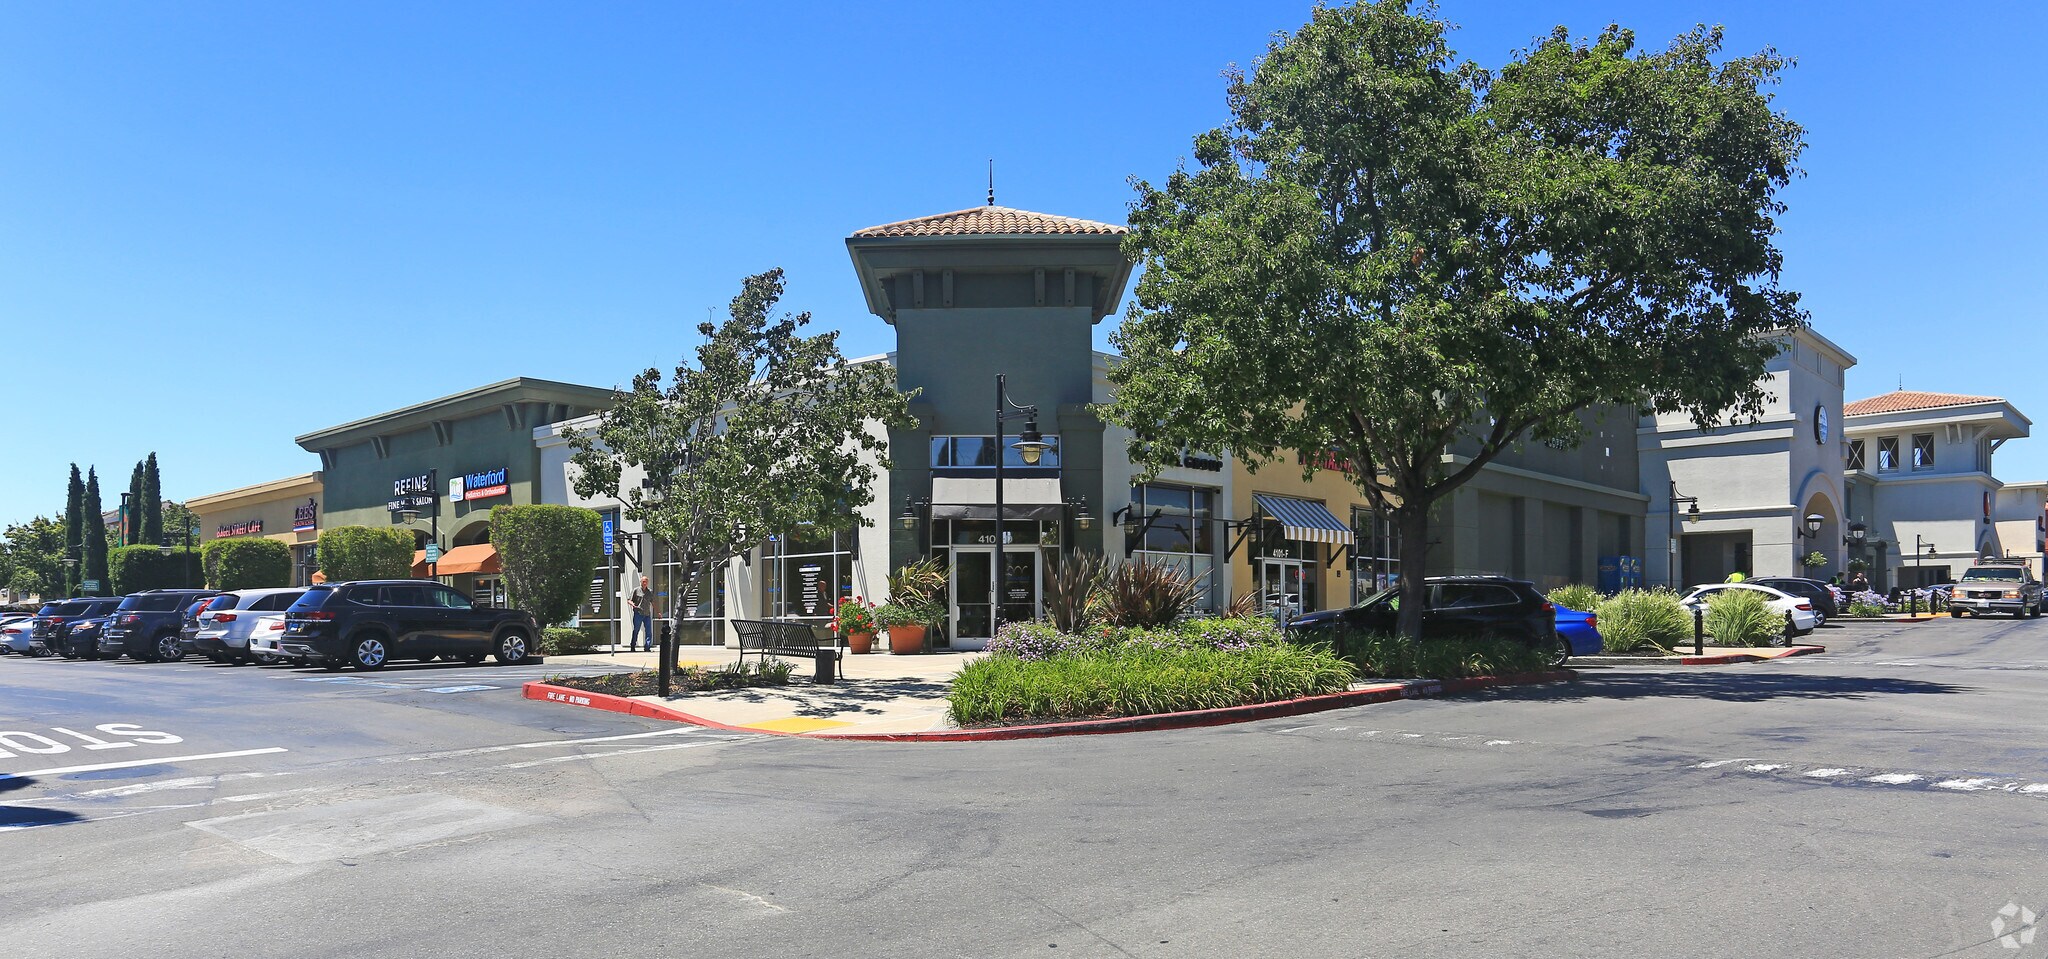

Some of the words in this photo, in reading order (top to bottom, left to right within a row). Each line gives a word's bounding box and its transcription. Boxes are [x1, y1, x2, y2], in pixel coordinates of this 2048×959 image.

[394, 475, 428, 496] REFINE
[465, 468, 505, 490] Waterford
[388, 500, 400, 510] FINE
[415, 496, 433, 506] SALON
[0, 723, 184, 759] STO
